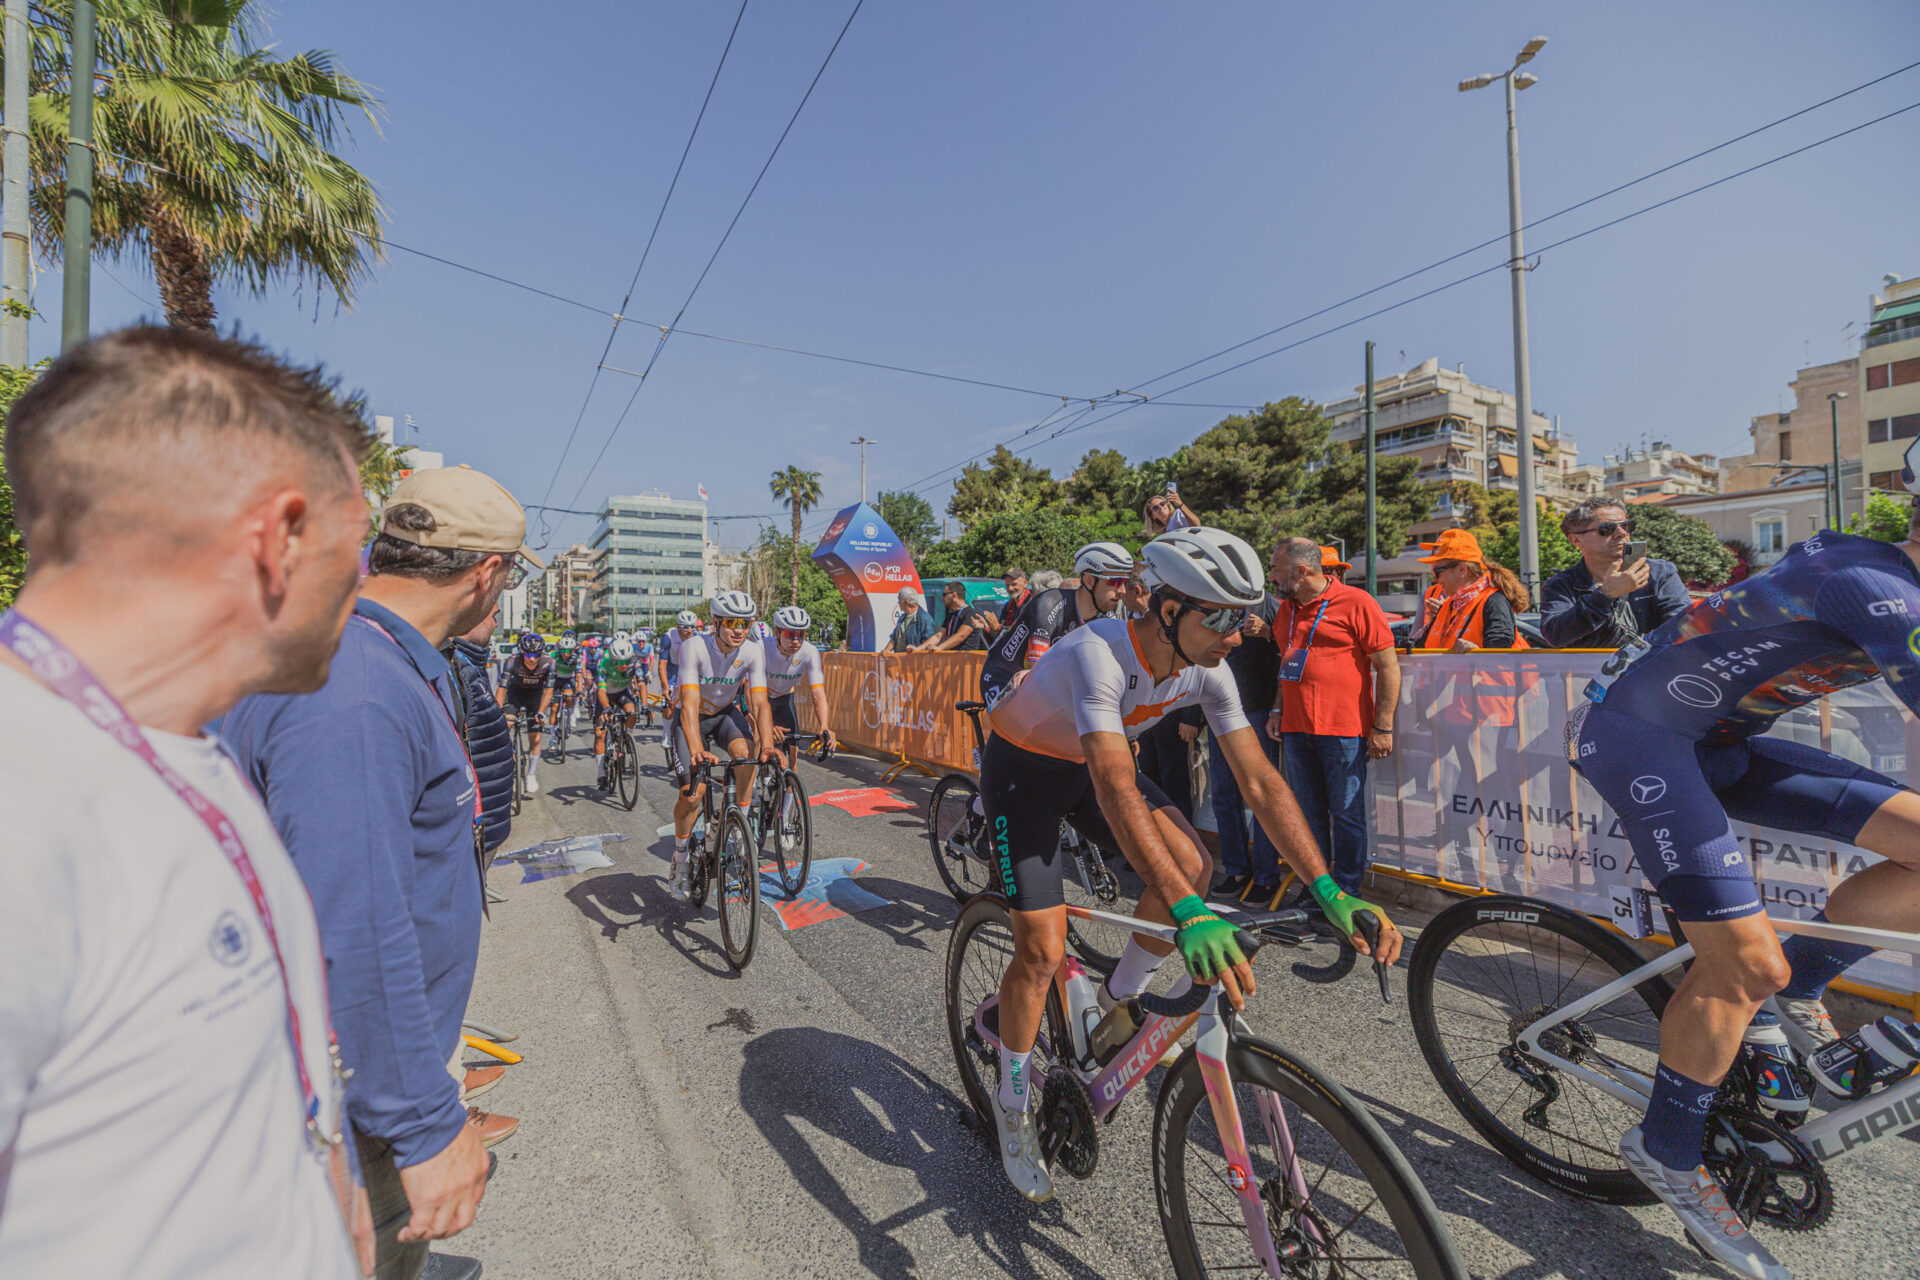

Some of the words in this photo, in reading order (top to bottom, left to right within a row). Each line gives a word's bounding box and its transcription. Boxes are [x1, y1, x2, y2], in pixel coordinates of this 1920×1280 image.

[885, 574, 913, 582] HELLAS
[1004, 626, 1027, 658] KASPER
[1702, 641, 1782, 673] TECAM
[1718, 657, 1760, 681] PCV
[889, 705, 935, 733] HELLAS
[1452, 794, 1598, 835] ΕΛΛΗΝΙΚΗ
[995, 815, 1017, 897] CYPRUS
[1477, 826, 1617, 871] Υπουργείο
[1653, 828, 1681, 873] SAGA
[1477, 910, 1540, 923] FFWD
[1612, 896, 1634, 919] 75
[1009, 1058, 1024, 1096] CYPRUS
[1102, 1047, 1151, 1101] QUICK
[1272, 1053, 1316, 1084] PIRELLI
